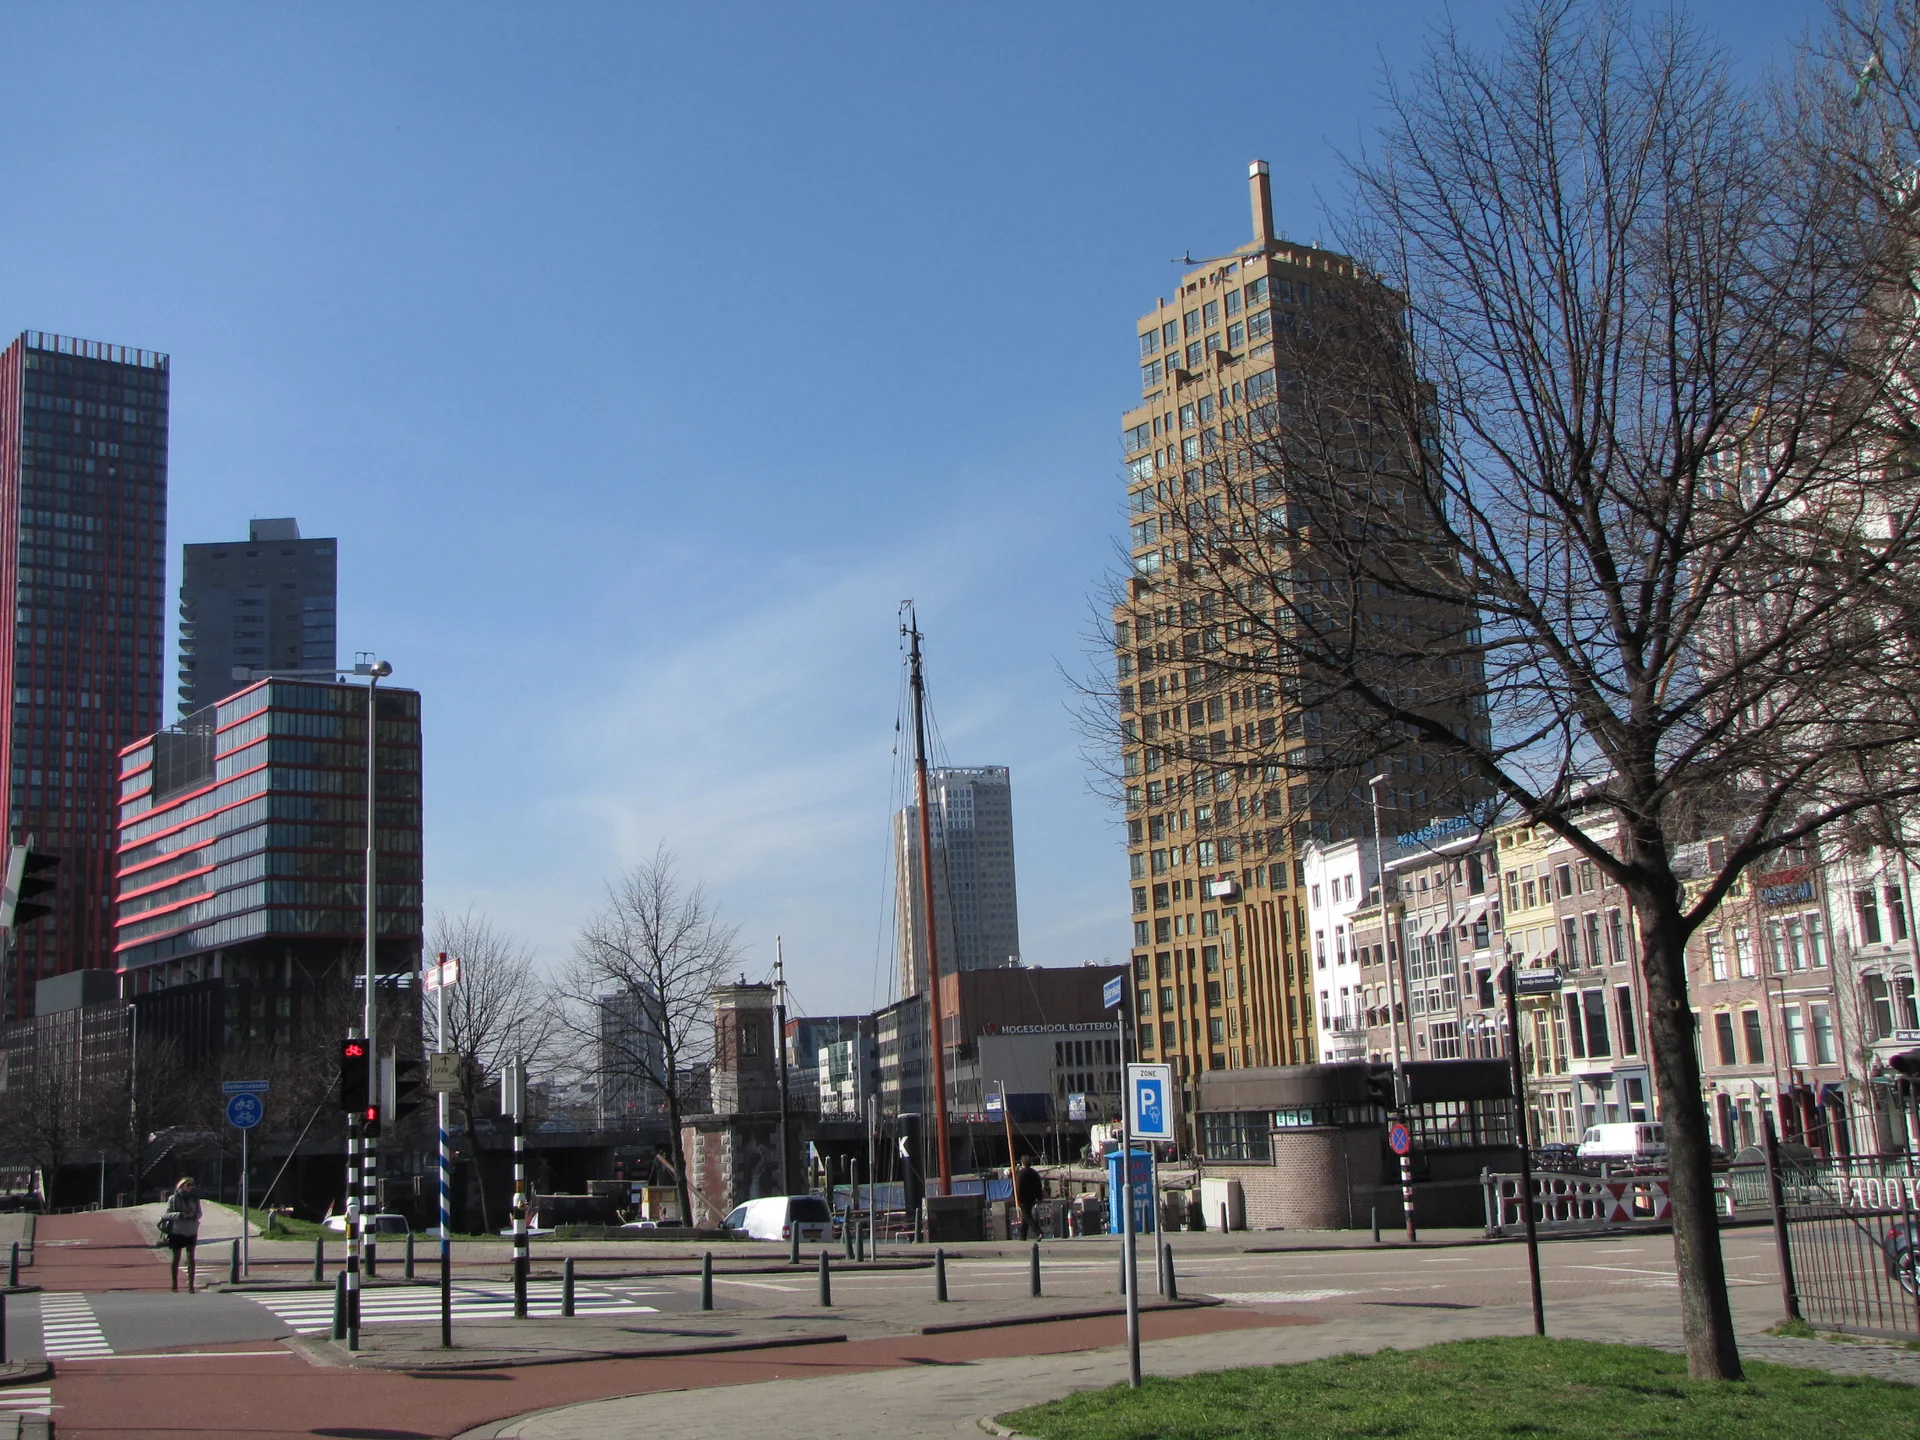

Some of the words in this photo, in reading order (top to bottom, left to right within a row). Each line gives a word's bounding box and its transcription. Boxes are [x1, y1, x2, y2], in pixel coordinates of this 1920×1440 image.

[1001, 1023, 1067, 1034] HOGESCHOOL
[1141, 1088, 1156, 1116] P
[898, 1135, 911, 1159] K
